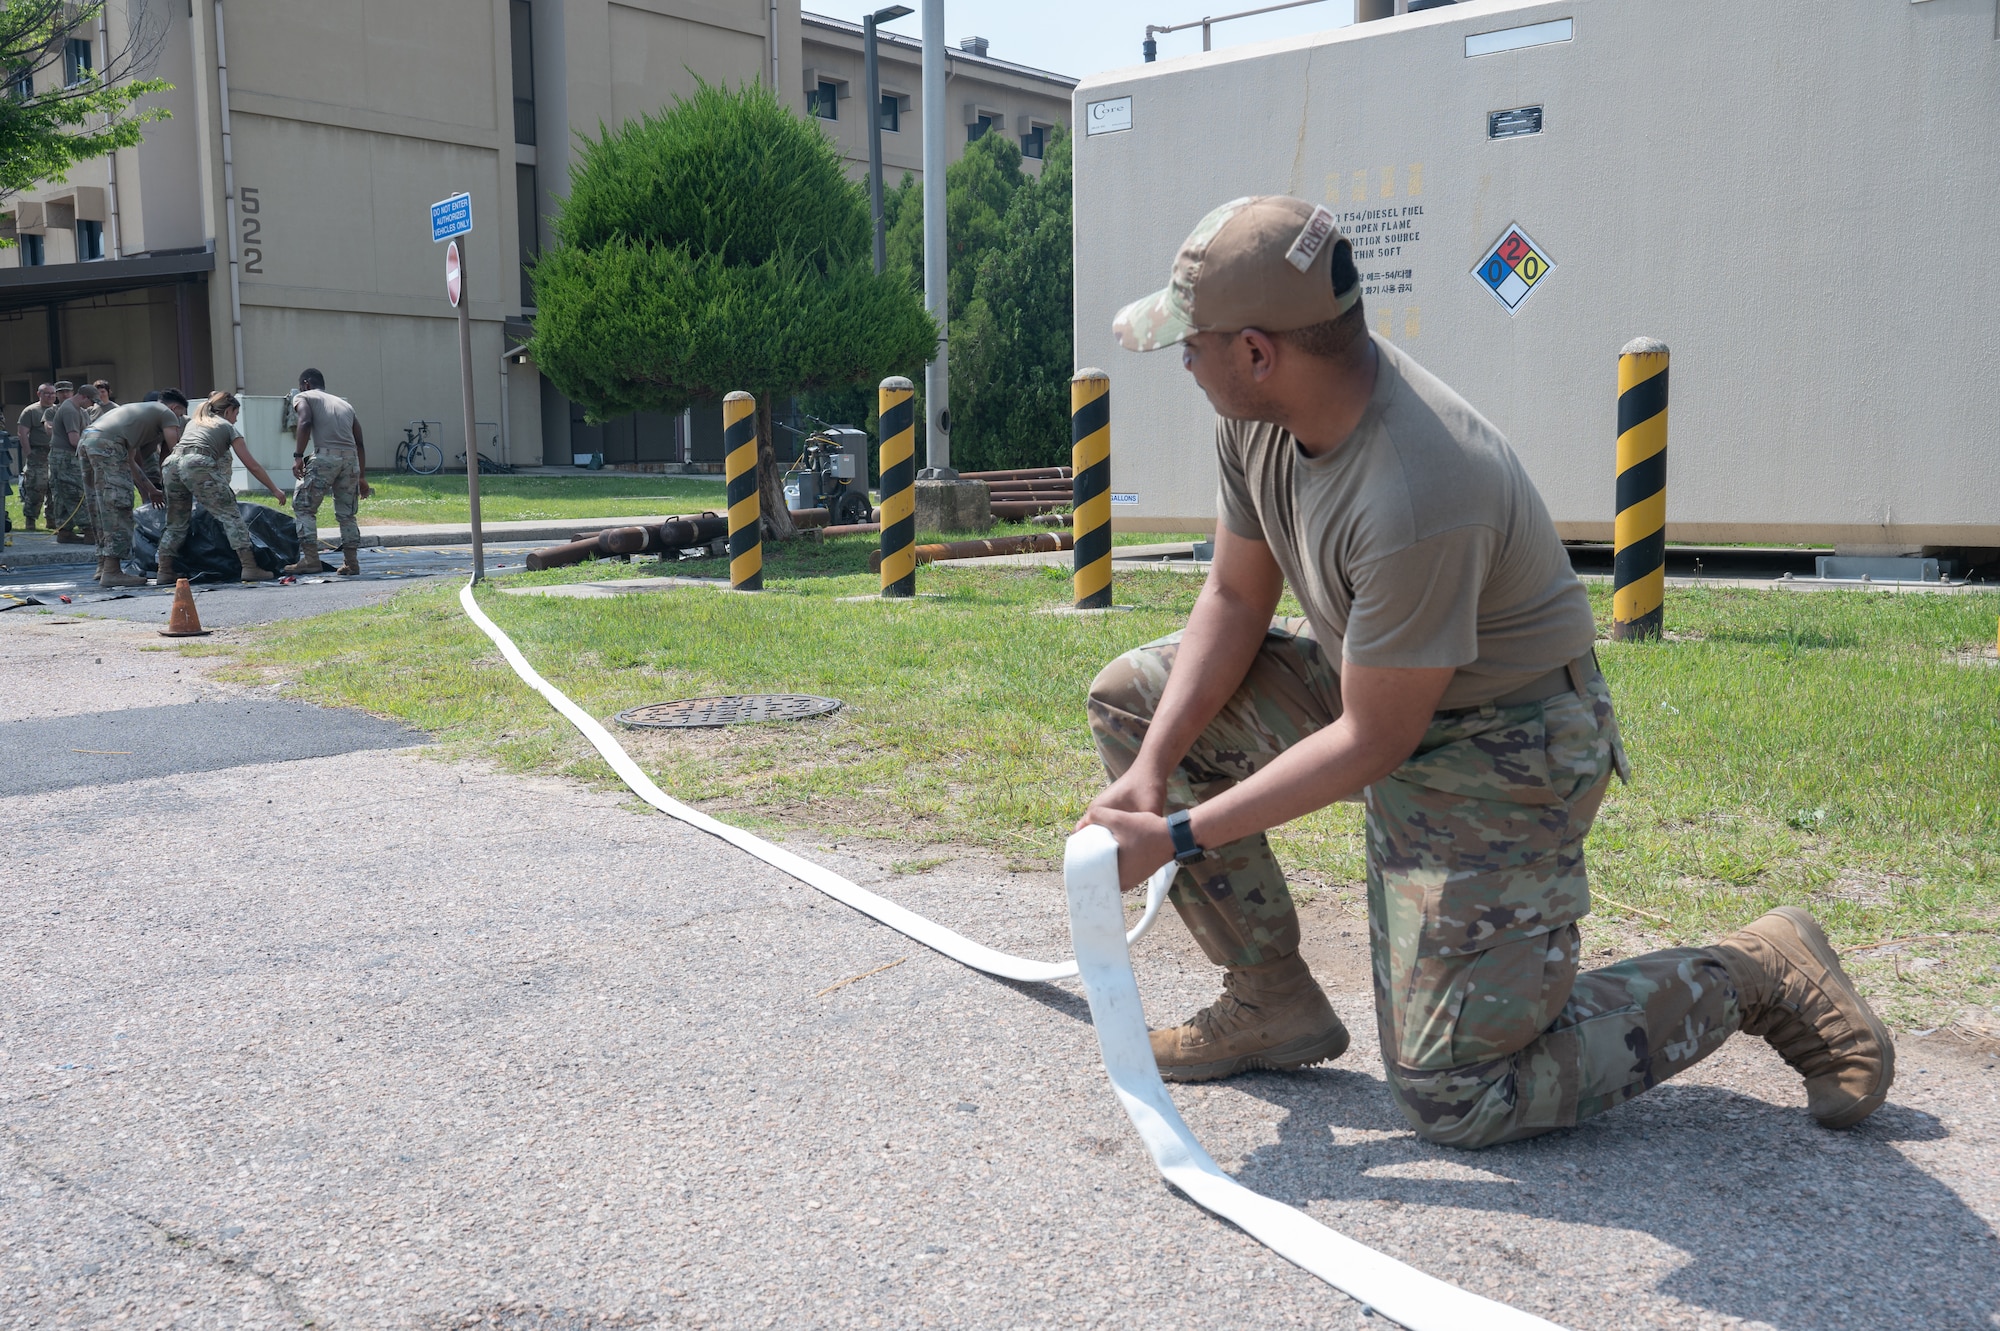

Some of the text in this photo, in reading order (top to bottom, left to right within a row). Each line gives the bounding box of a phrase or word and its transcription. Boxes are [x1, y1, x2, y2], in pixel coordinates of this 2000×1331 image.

[1093, 103, 1125, 120] Core
[433, 199, 467, 216] DO NOT ENTER
[1344, 207, 1398, 222] F54/DIESEL
[1402, 206, 1424, 217] FUEL
[437, 210, 466, 225] AUTHORIZED
[241, 187, 263, 274] 522
[435, 219, 469, 236] VEHICLES ONLY
[1340, 219, 1412, 235] NO OPEN FLAME
[1350, 231, 1420, 247] NITION SOURCE
[1354, 249, 1375, 260] THIN
[1506, 237, 1521, 261] 2
[1488, 259, 1503, 282] 0
[1523, 256, 1539, 280] 0
[1381, 284, 1396, 294] 사용
